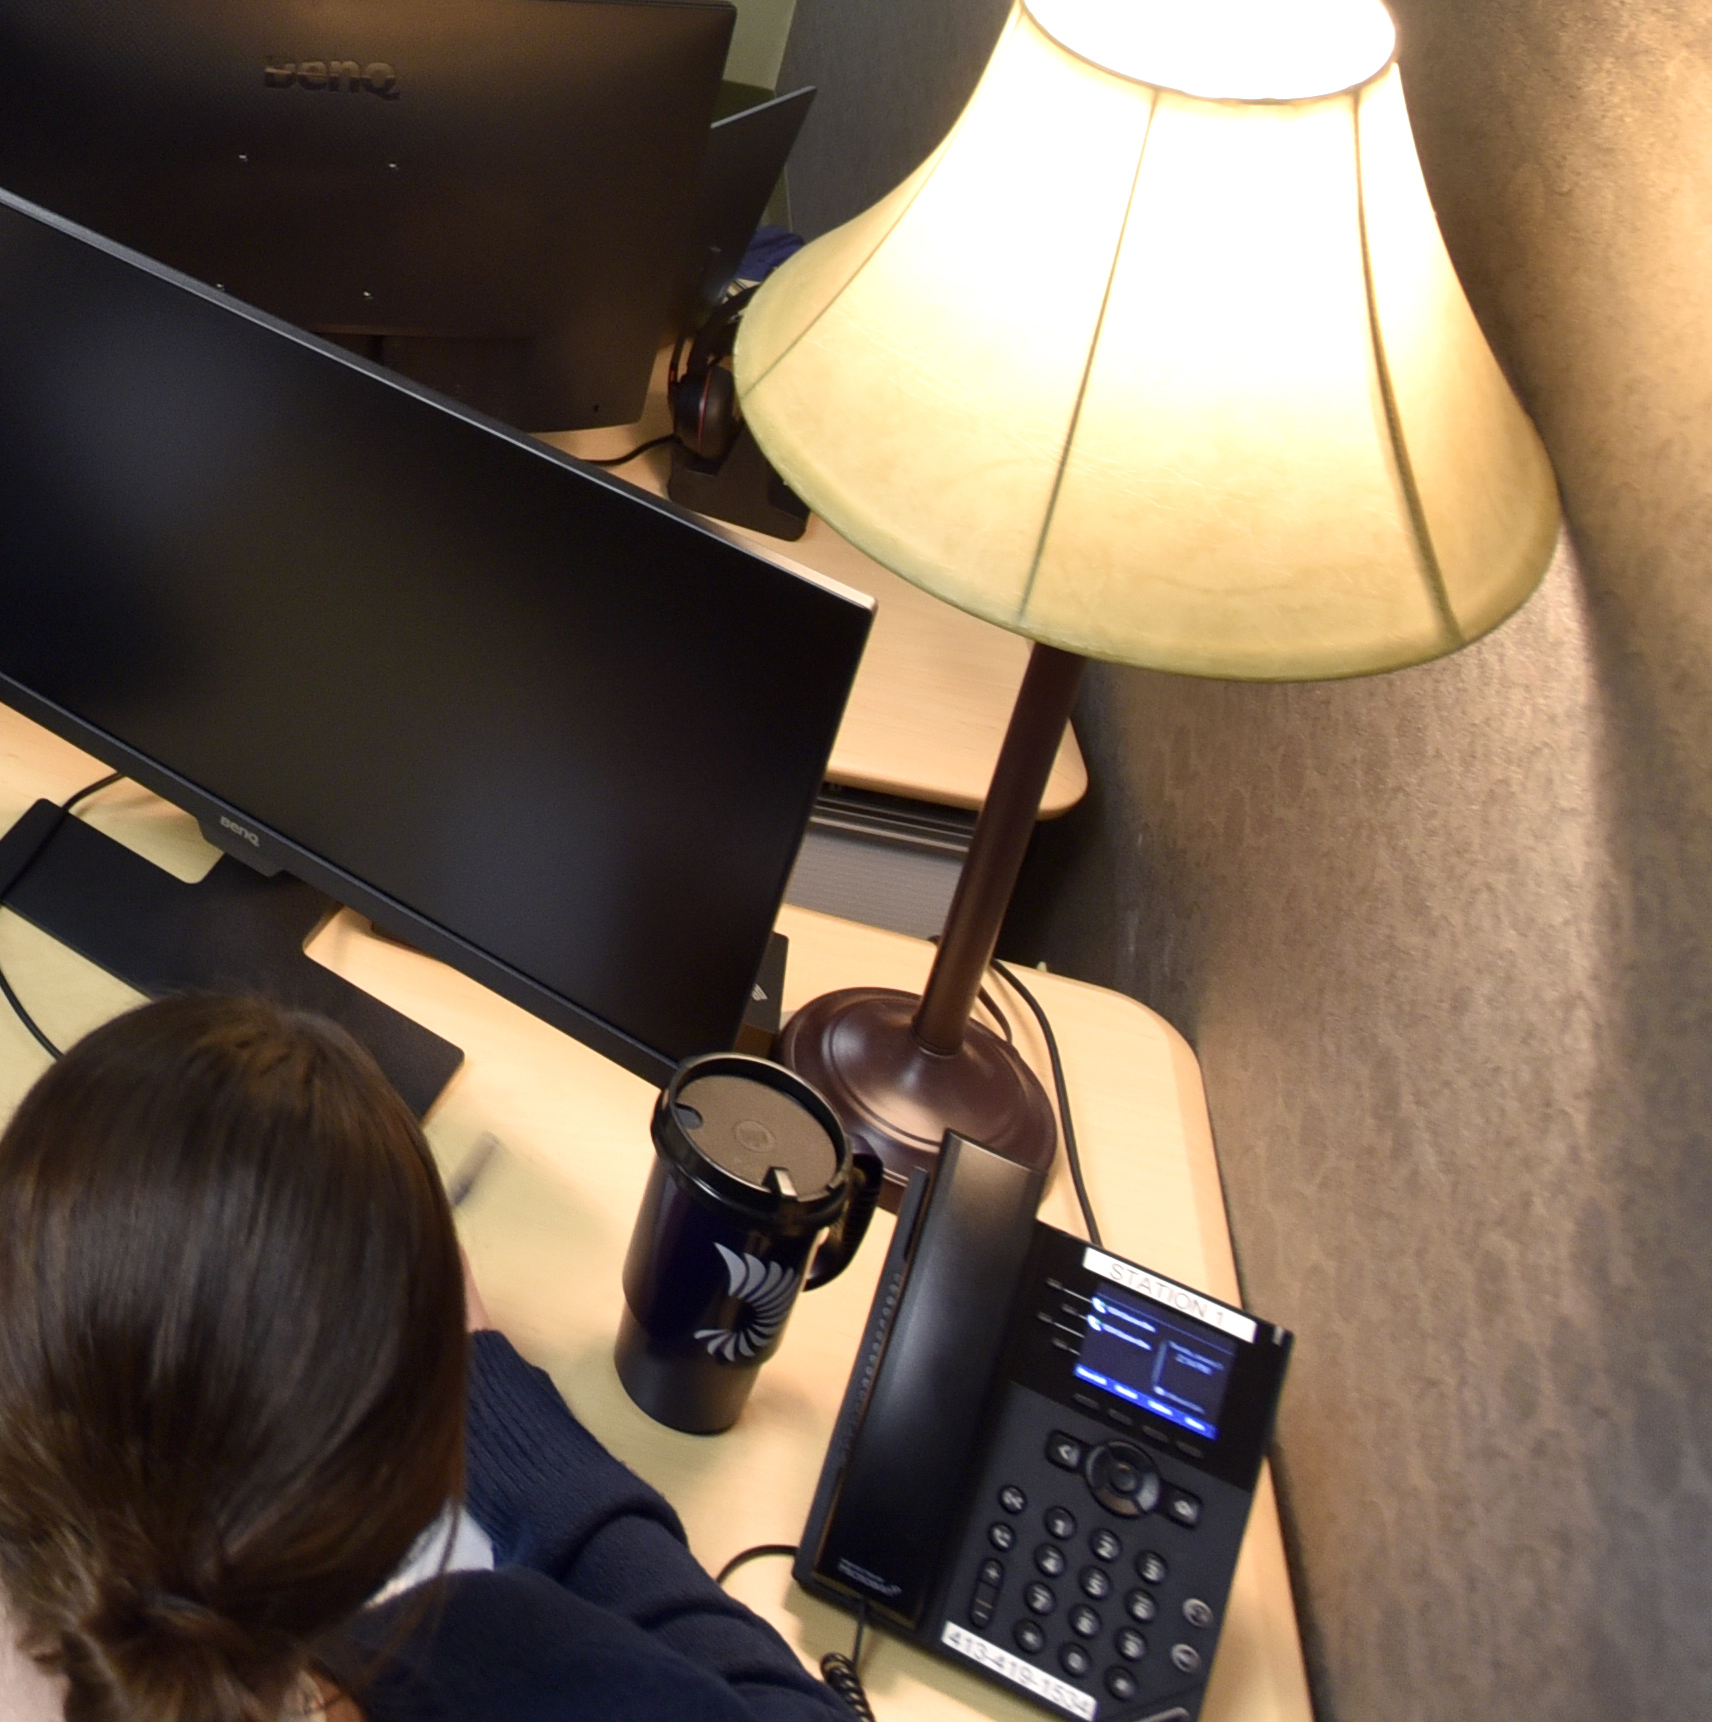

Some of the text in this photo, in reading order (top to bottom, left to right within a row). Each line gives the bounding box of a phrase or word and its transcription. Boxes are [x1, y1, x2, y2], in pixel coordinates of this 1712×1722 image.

[263, 58, 401, 102] BenQ
[219, 815, 261, 849] BenQ
[1107, 1260, 1226, 1326] STATION 1
